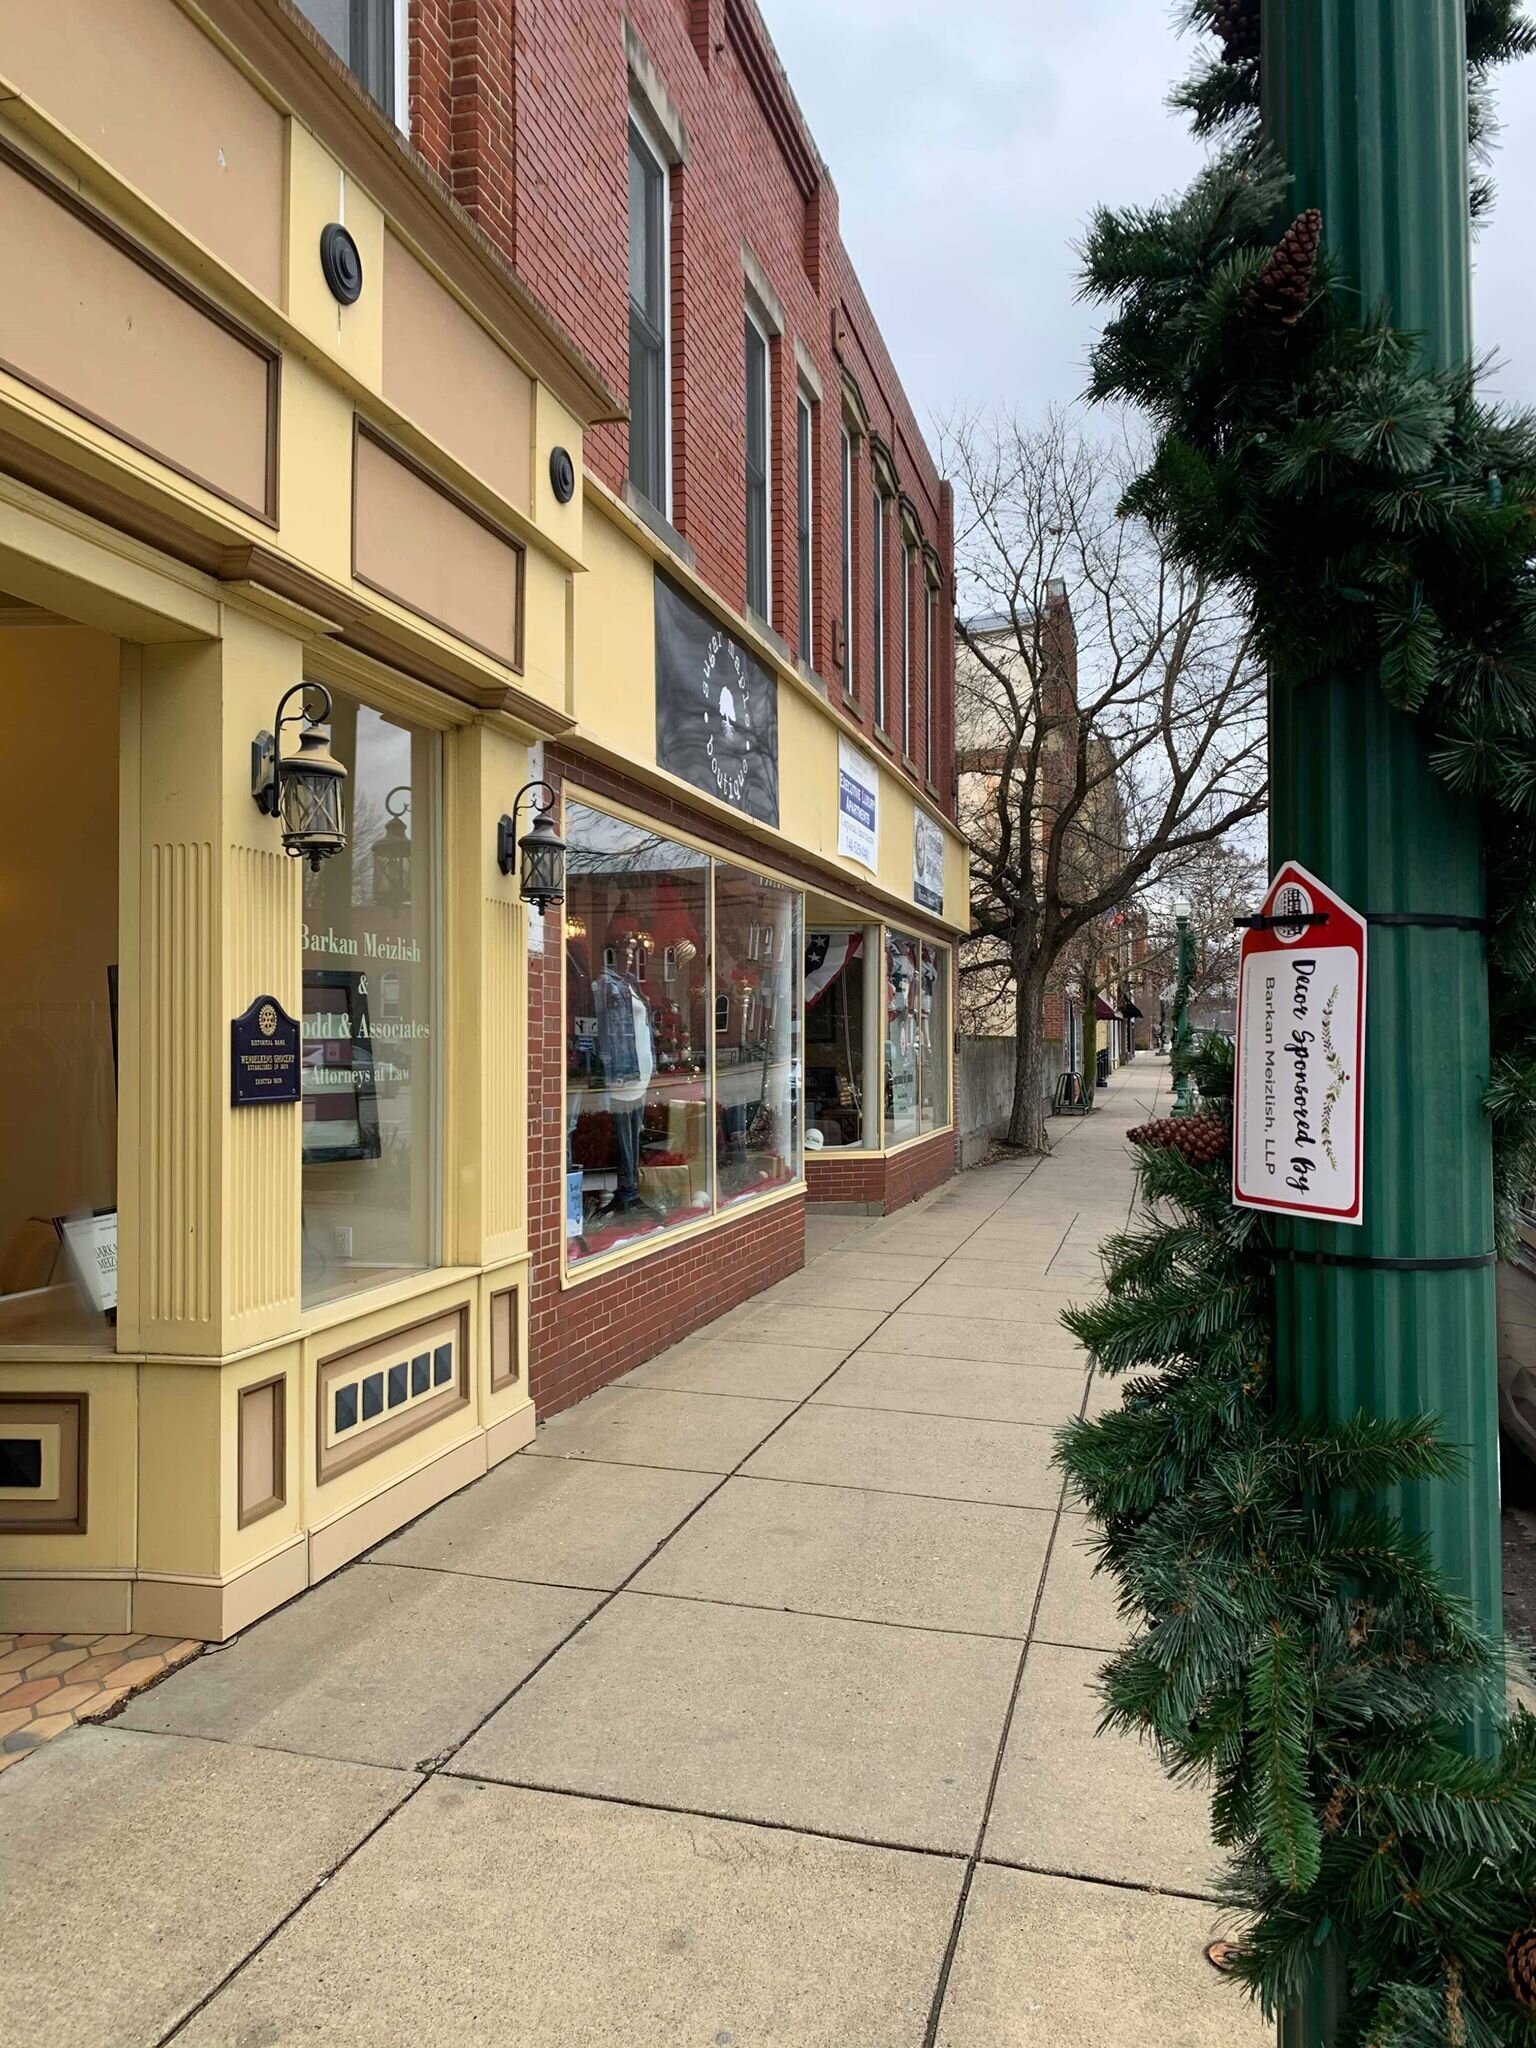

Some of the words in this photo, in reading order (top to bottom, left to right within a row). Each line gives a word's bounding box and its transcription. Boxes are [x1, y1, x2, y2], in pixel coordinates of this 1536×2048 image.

[702, 631, 723, 698] sugar
[727, 637, 750, 728] maple
[706, 733, 748, 801] boutique
[301, 923, 358, 955] Barkan
[363, 932, 420, 962] Meizlish
[358, 975, 368, 995] &
[1264, 976, 1276, 1044] Barkan
[1291, 959, 1317, 1021] Decor
[301, 1012, 332, 1039] odd
[339, 1013, 352, 1038] &
[357, 1013, 430, 1039] Associates
[311, 1065, 371, 1088] Attorneys
[374, 1065, 385, 1081] at
[389, 1063, 410, 1081] Law
[1263, 1050, 1276, 1132] Meizlish,
[1284, 1029, 1317, 1149] Sponsored
[1264, 1138, 1276, 1175] LLP
[1285, 1156, 1317, 1196] By
